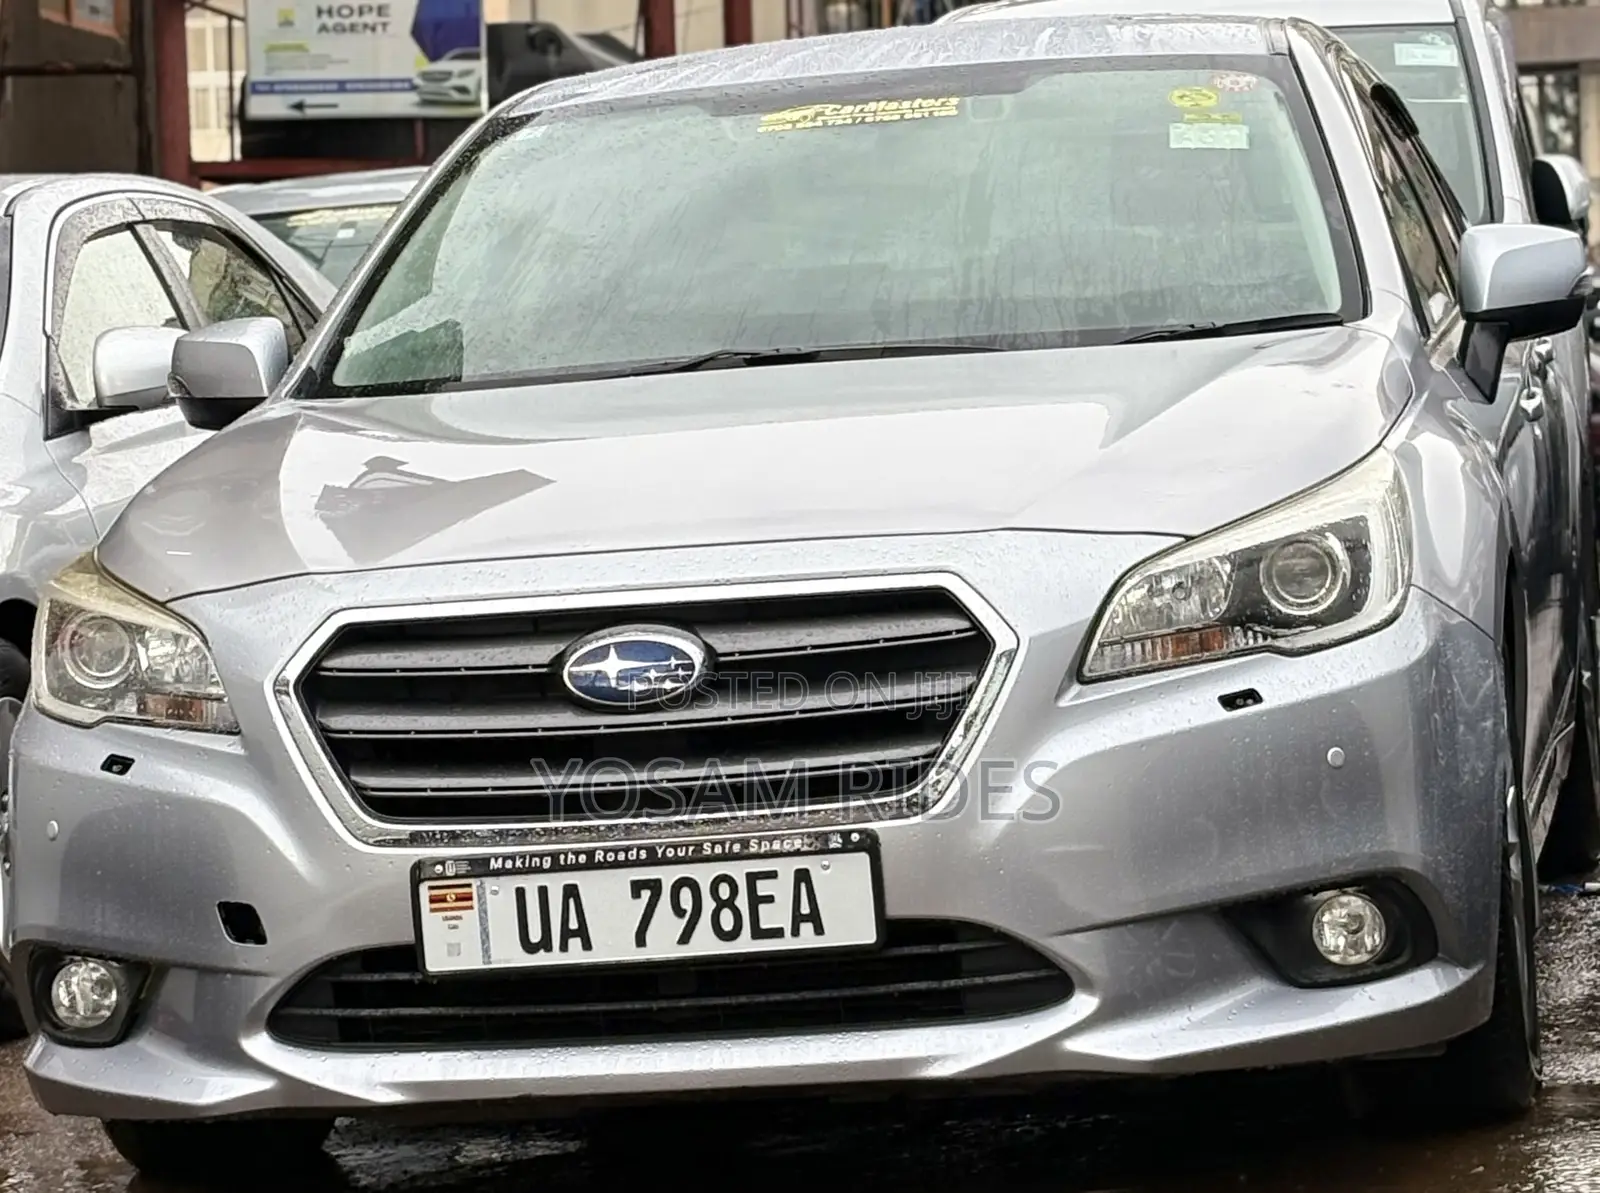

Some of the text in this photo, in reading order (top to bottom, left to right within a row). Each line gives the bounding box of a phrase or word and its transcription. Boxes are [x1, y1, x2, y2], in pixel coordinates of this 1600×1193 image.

[316, 4, 392, 19] HOPE
[316, 22, 391, 35] AGENT
[489, 855, 551, 870] Making
[559, 852, 587, 865] the
[595, 848, 647, 863] Roads
[655, 845, 695, 858] Your
[702, 841, 741, 855] Safe
[514, 867, 826, 955] UA 798EA
